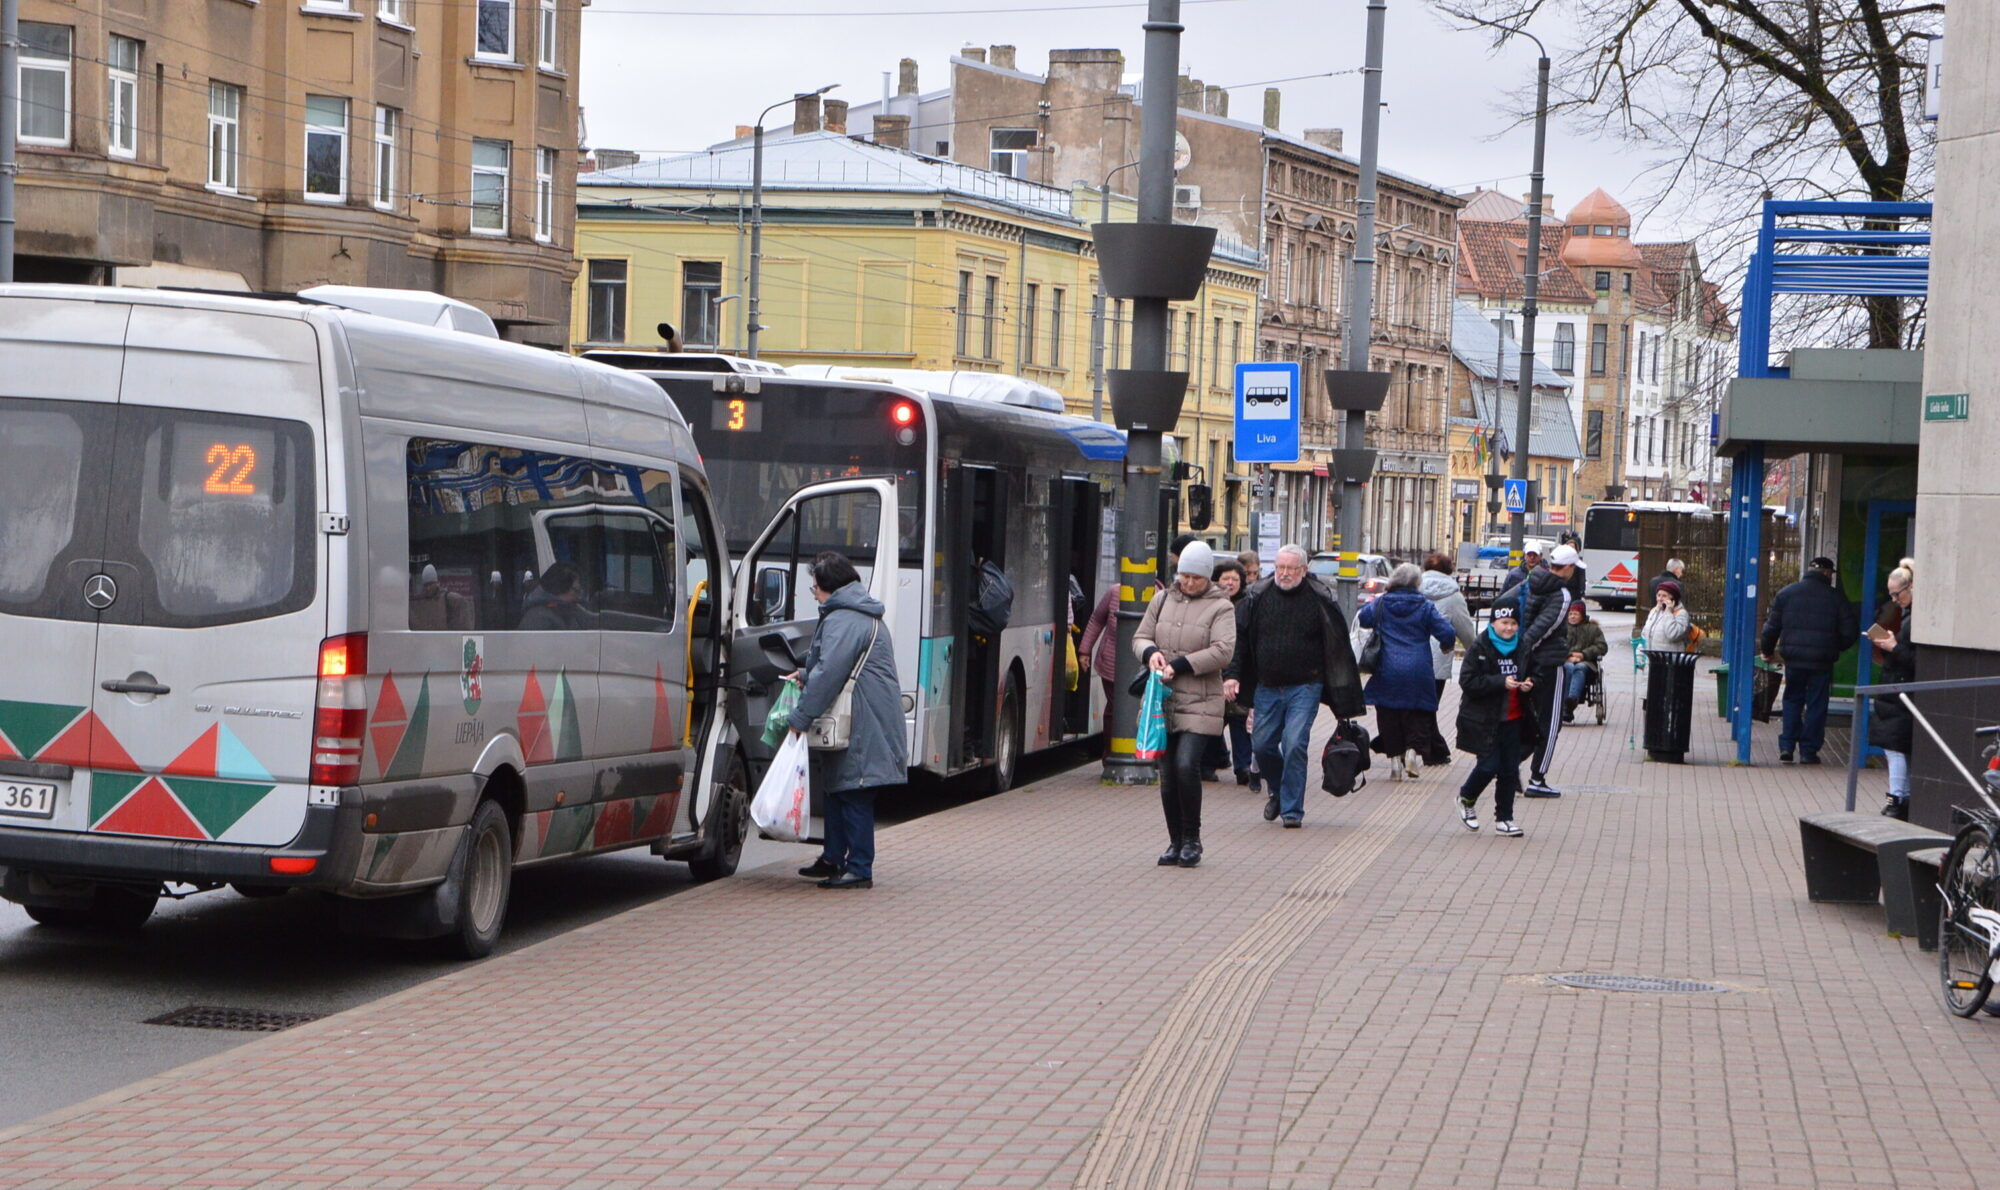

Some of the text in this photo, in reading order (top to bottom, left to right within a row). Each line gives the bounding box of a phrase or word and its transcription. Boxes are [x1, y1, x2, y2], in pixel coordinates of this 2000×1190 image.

[728, 399, 745, 431] 3
[1957, 395, 1967, 416] 11
[205, 444, 255, 493] 22
[1627, 512, 1635, 522] 7
[1494, 608, 1514, 619] BOY
[223, 705, 304, 720] BLUETEC
[455, 718, 484, 746] LIEPĀJA
[4, 785, 47, 810] 361
